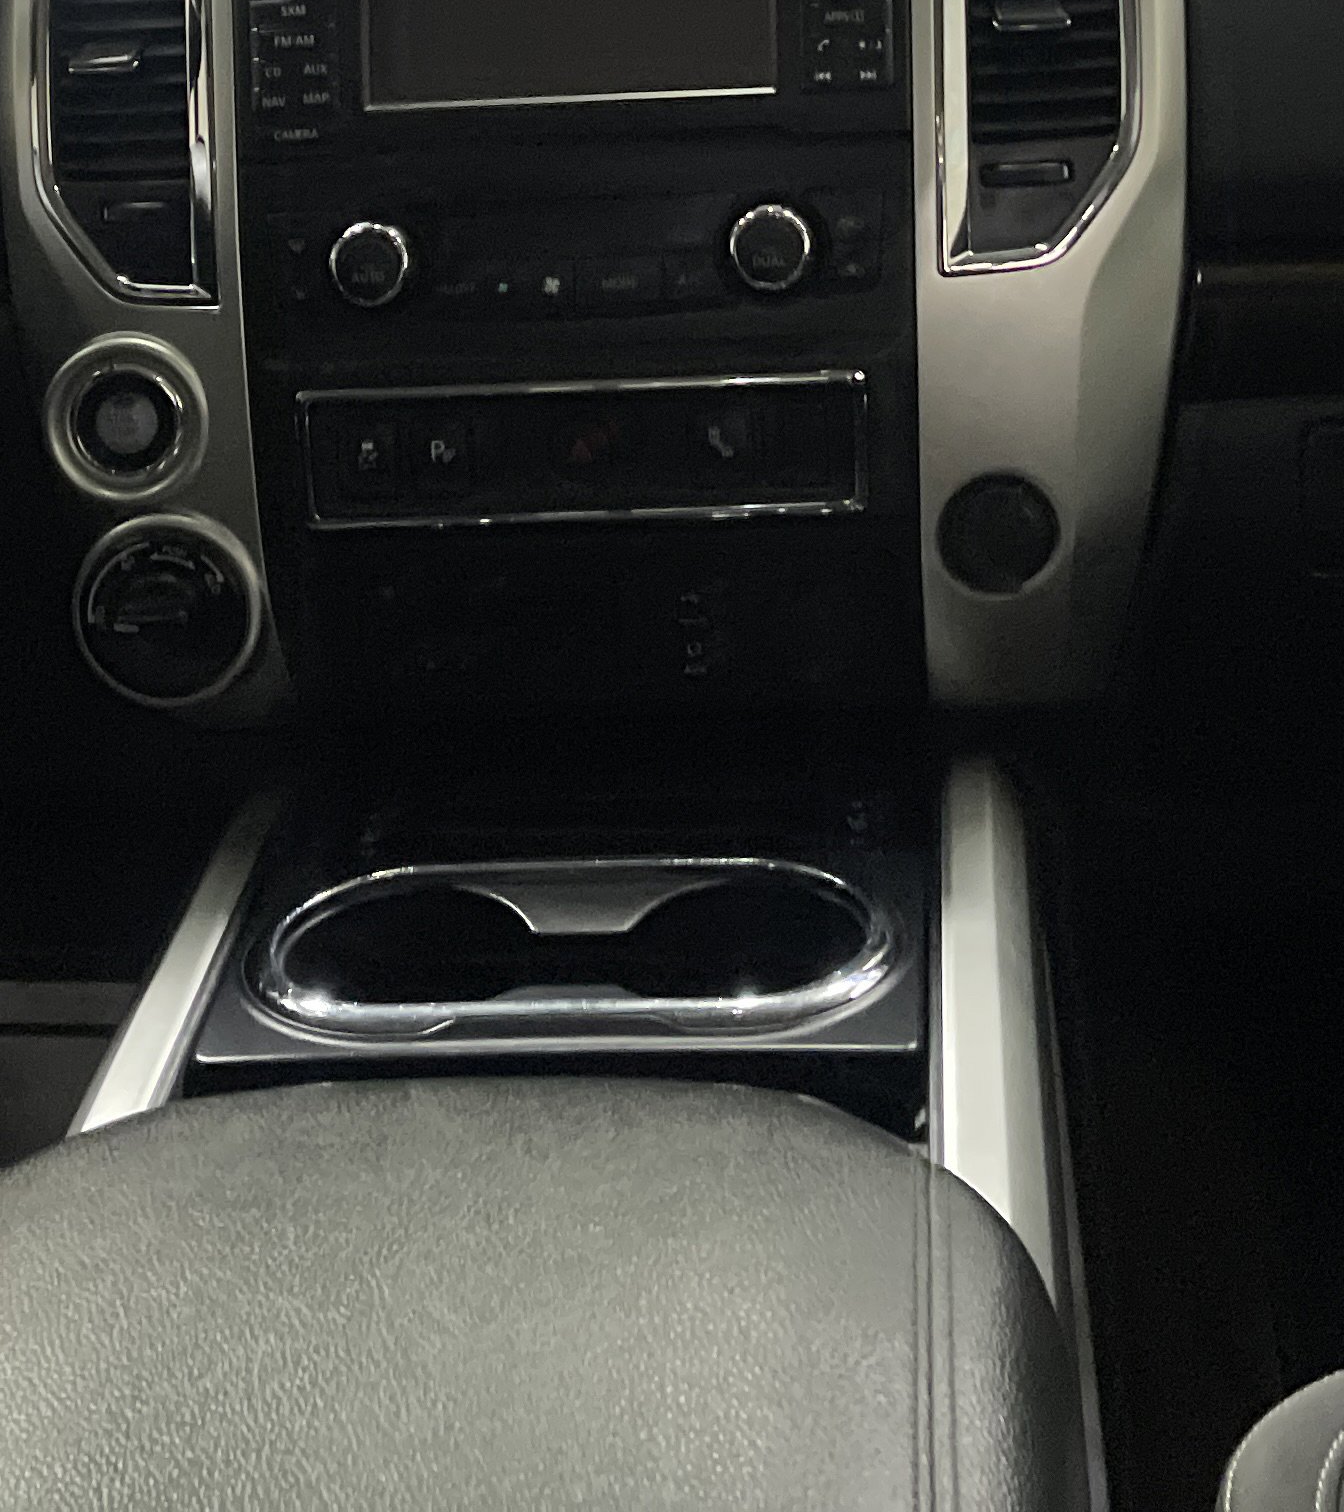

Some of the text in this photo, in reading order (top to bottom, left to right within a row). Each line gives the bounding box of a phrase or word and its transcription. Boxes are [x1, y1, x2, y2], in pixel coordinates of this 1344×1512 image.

[304, 64, 328, 76] AUX
[262, 96, 287, 108] NAV
[303, 92, 330, 105] MAP
[274, 128, 319, 142] CAMERA
